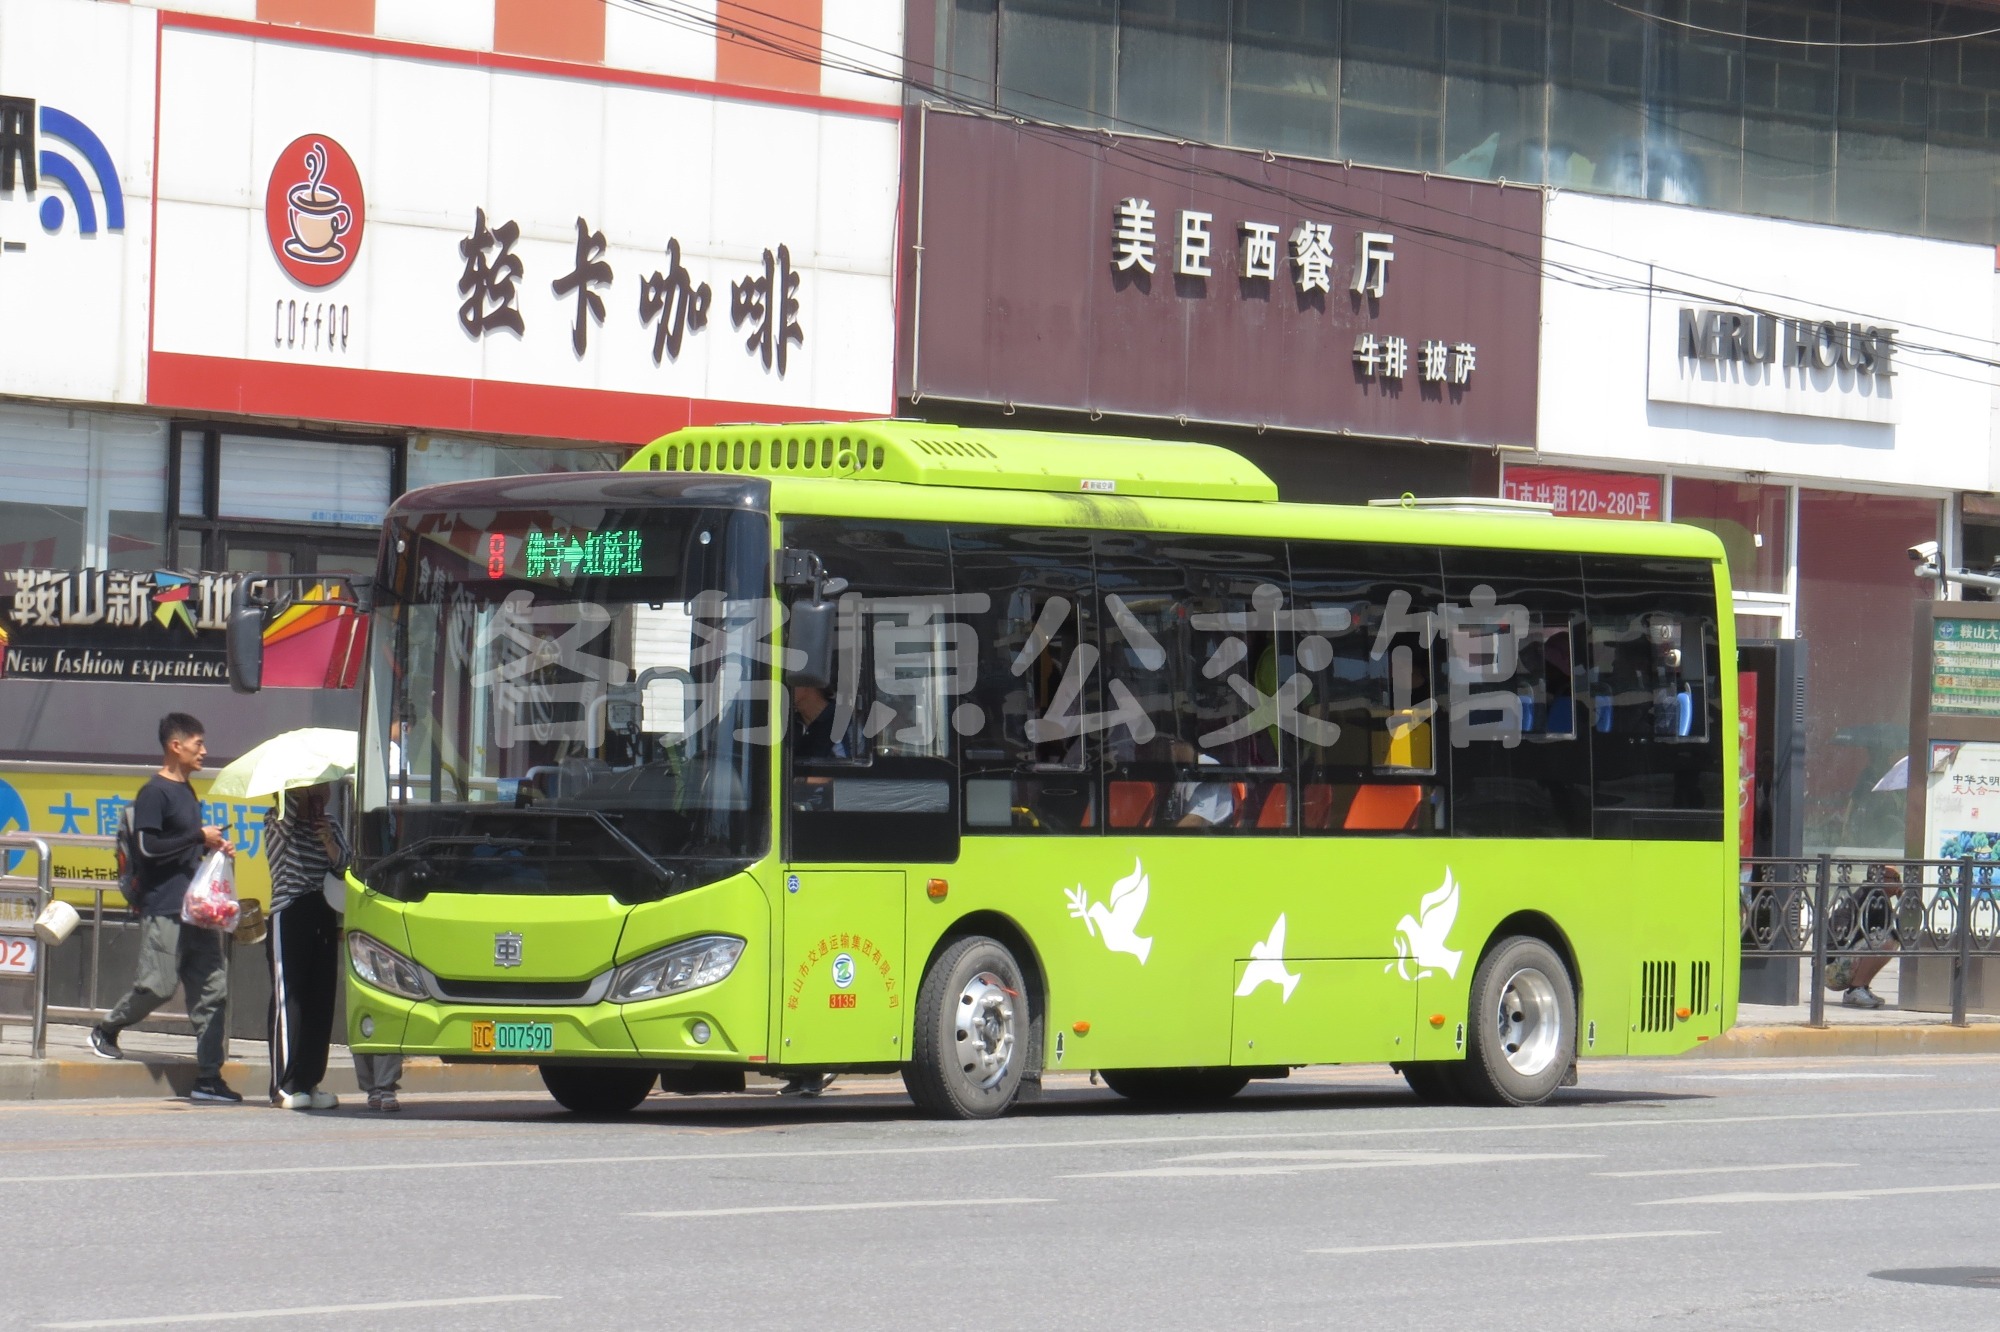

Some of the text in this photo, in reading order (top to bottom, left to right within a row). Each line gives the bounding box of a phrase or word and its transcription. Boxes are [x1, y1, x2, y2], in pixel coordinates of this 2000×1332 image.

[1113, 197, 1395, 299] 美臣西餐厅
[458, 206, 804, 377] 轻卡咖啡
[1354, 333, 1477, 385] 牛排 披萨
[1783, 320, 1899, 376] HOUSE
[488, 533, 505, 579] 8
[1960, 624, 2000, 640] 鞍山大
[132, 654, 230, 681] experienc
[1952, 774, 2000, 787] 中华文明
[1952, 785, 2000, 796] 天人合一
[830, 995, 856, 1008] 3135
